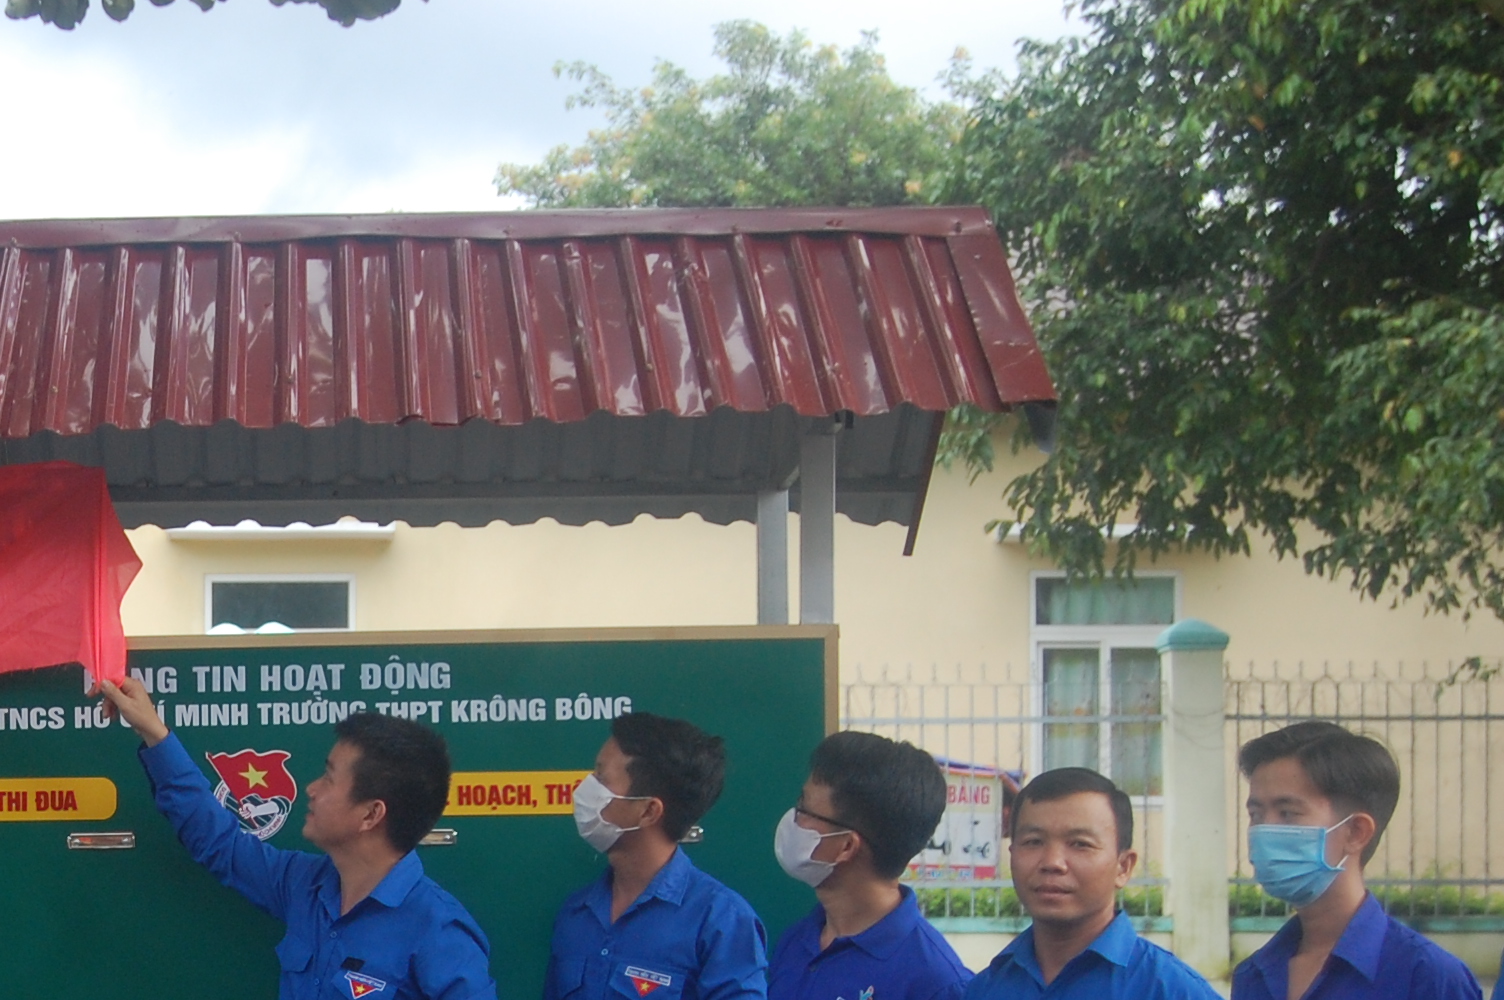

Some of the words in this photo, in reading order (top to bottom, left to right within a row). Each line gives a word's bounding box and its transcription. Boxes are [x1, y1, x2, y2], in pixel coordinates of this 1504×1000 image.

[193, 665, 247, 692] TIN
[260, 663, 345, 698] HOẠT
[359, 654, 451, 695] ĐỘNG
[175, 703, 248, 728] MINH
[375, 701, 443, 723] THPT
[451, 694, 546, 723] KRÔNG
[555, 692, 632, 720] BÔNG
[35, 788, 78, 812] ĐUA
[457, 784, 538, 811] HOẠCH,
